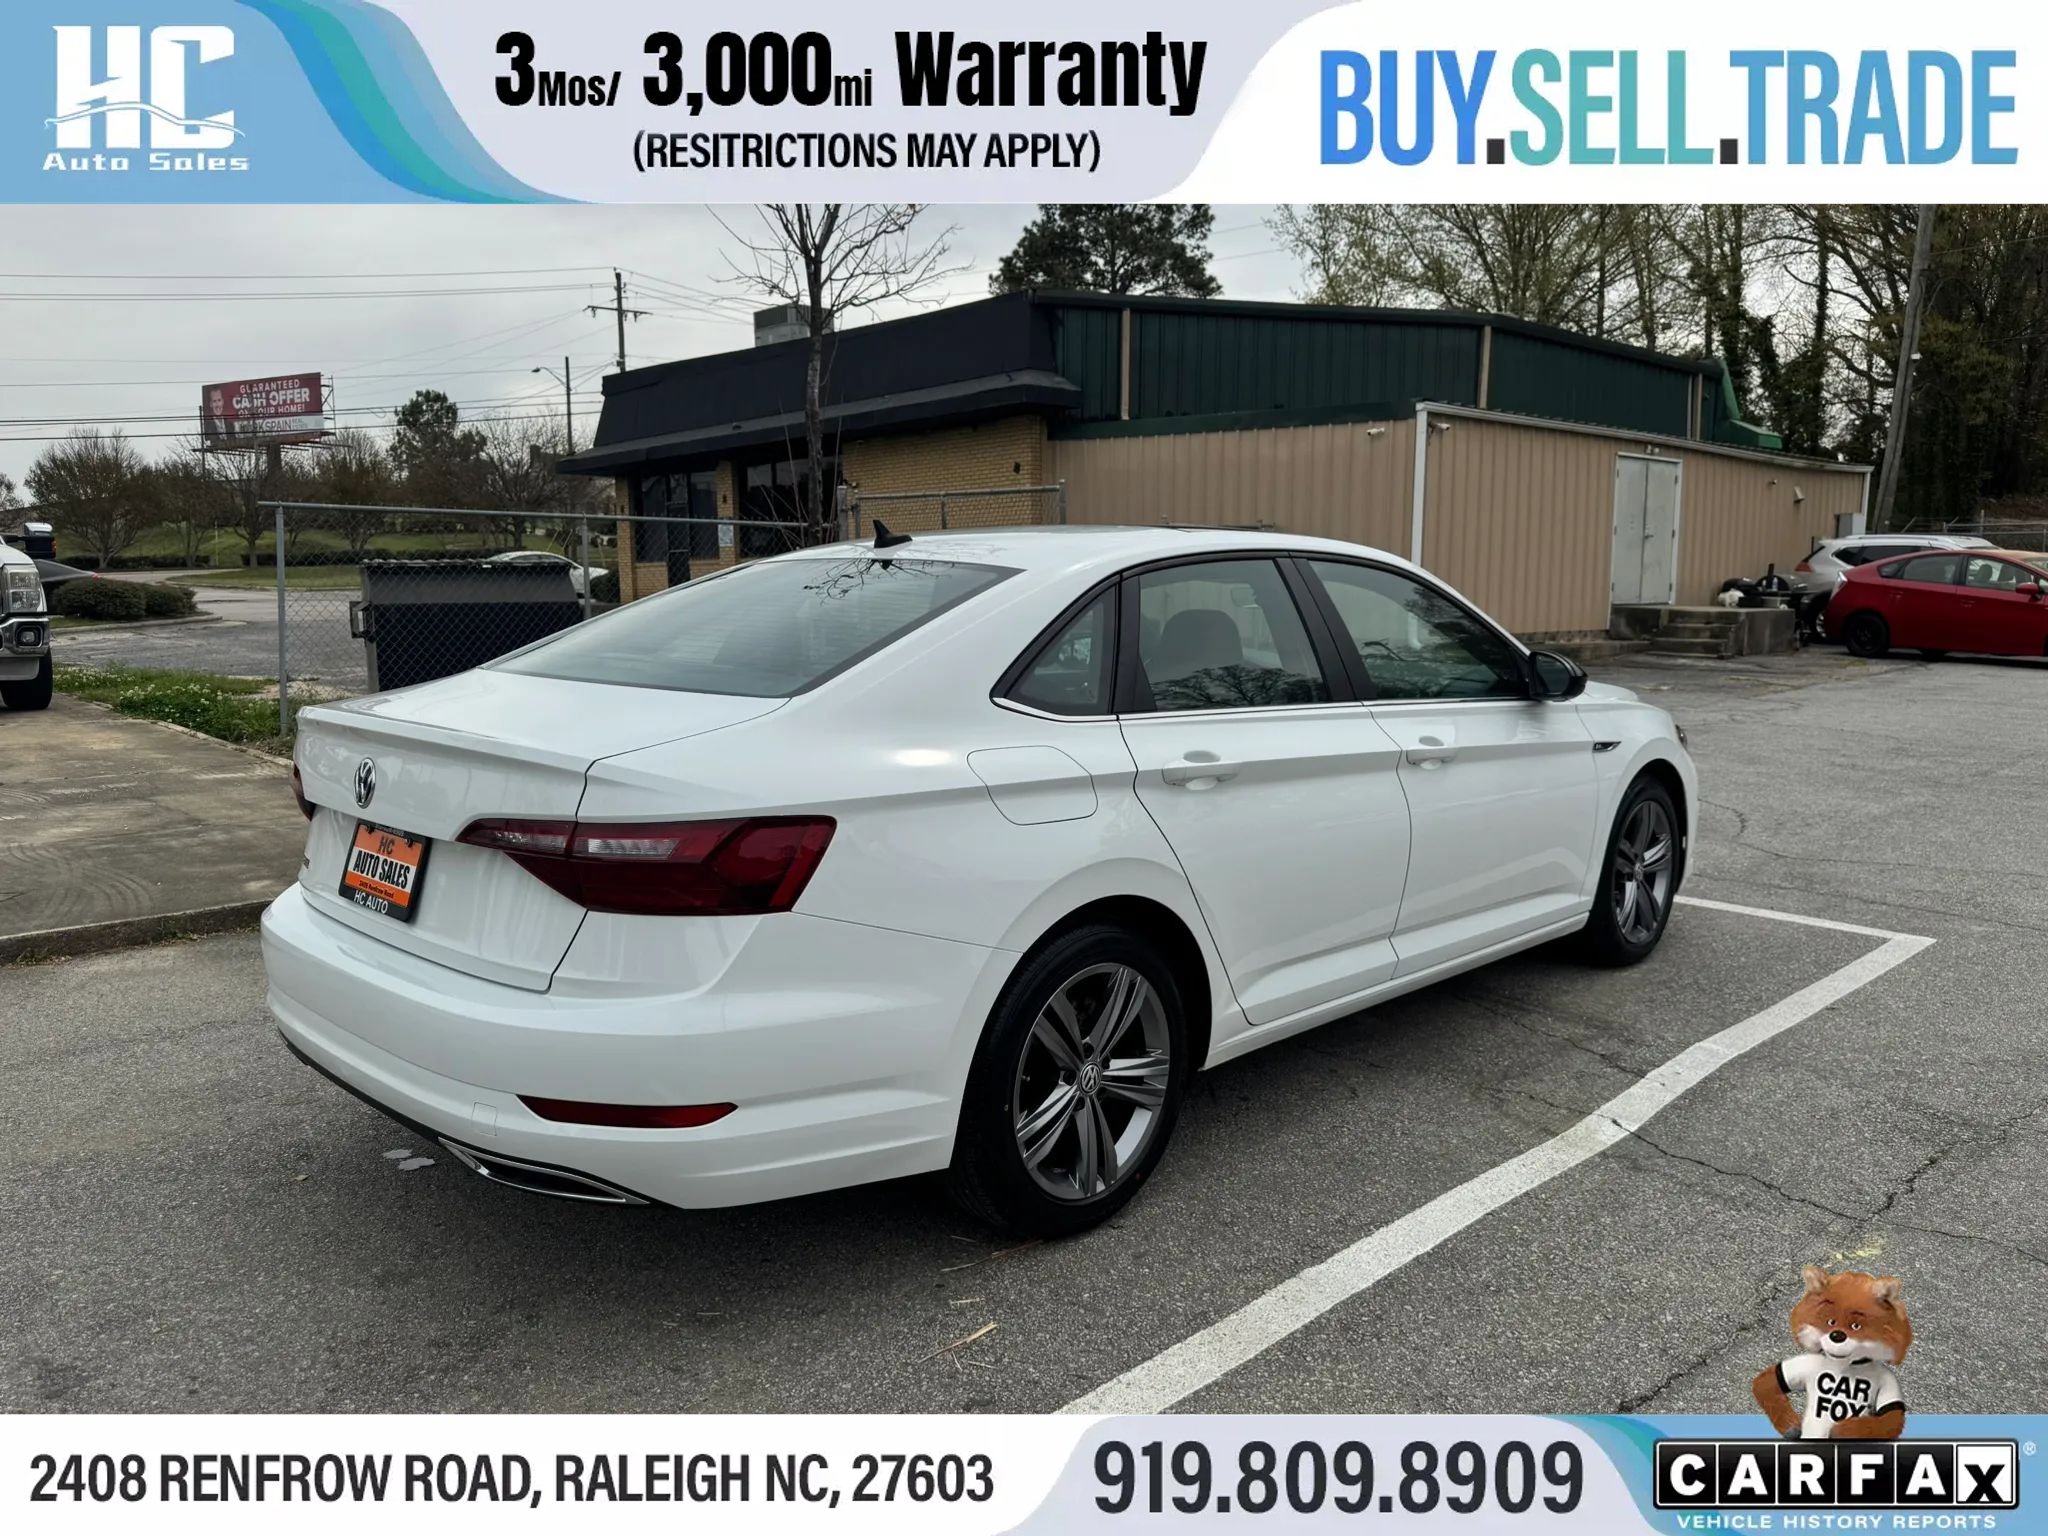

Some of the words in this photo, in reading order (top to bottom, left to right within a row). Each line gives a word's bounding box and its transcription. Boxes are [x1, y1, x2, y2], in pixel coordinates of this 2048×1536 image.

[269, 388, 311, 406] OFFER
[353, 850, 379, 878] AUTO
[380, 858, 410, 889] SALES
[354, 890, 366, 905] HC
[366, 895, 389, 914] AUTO
